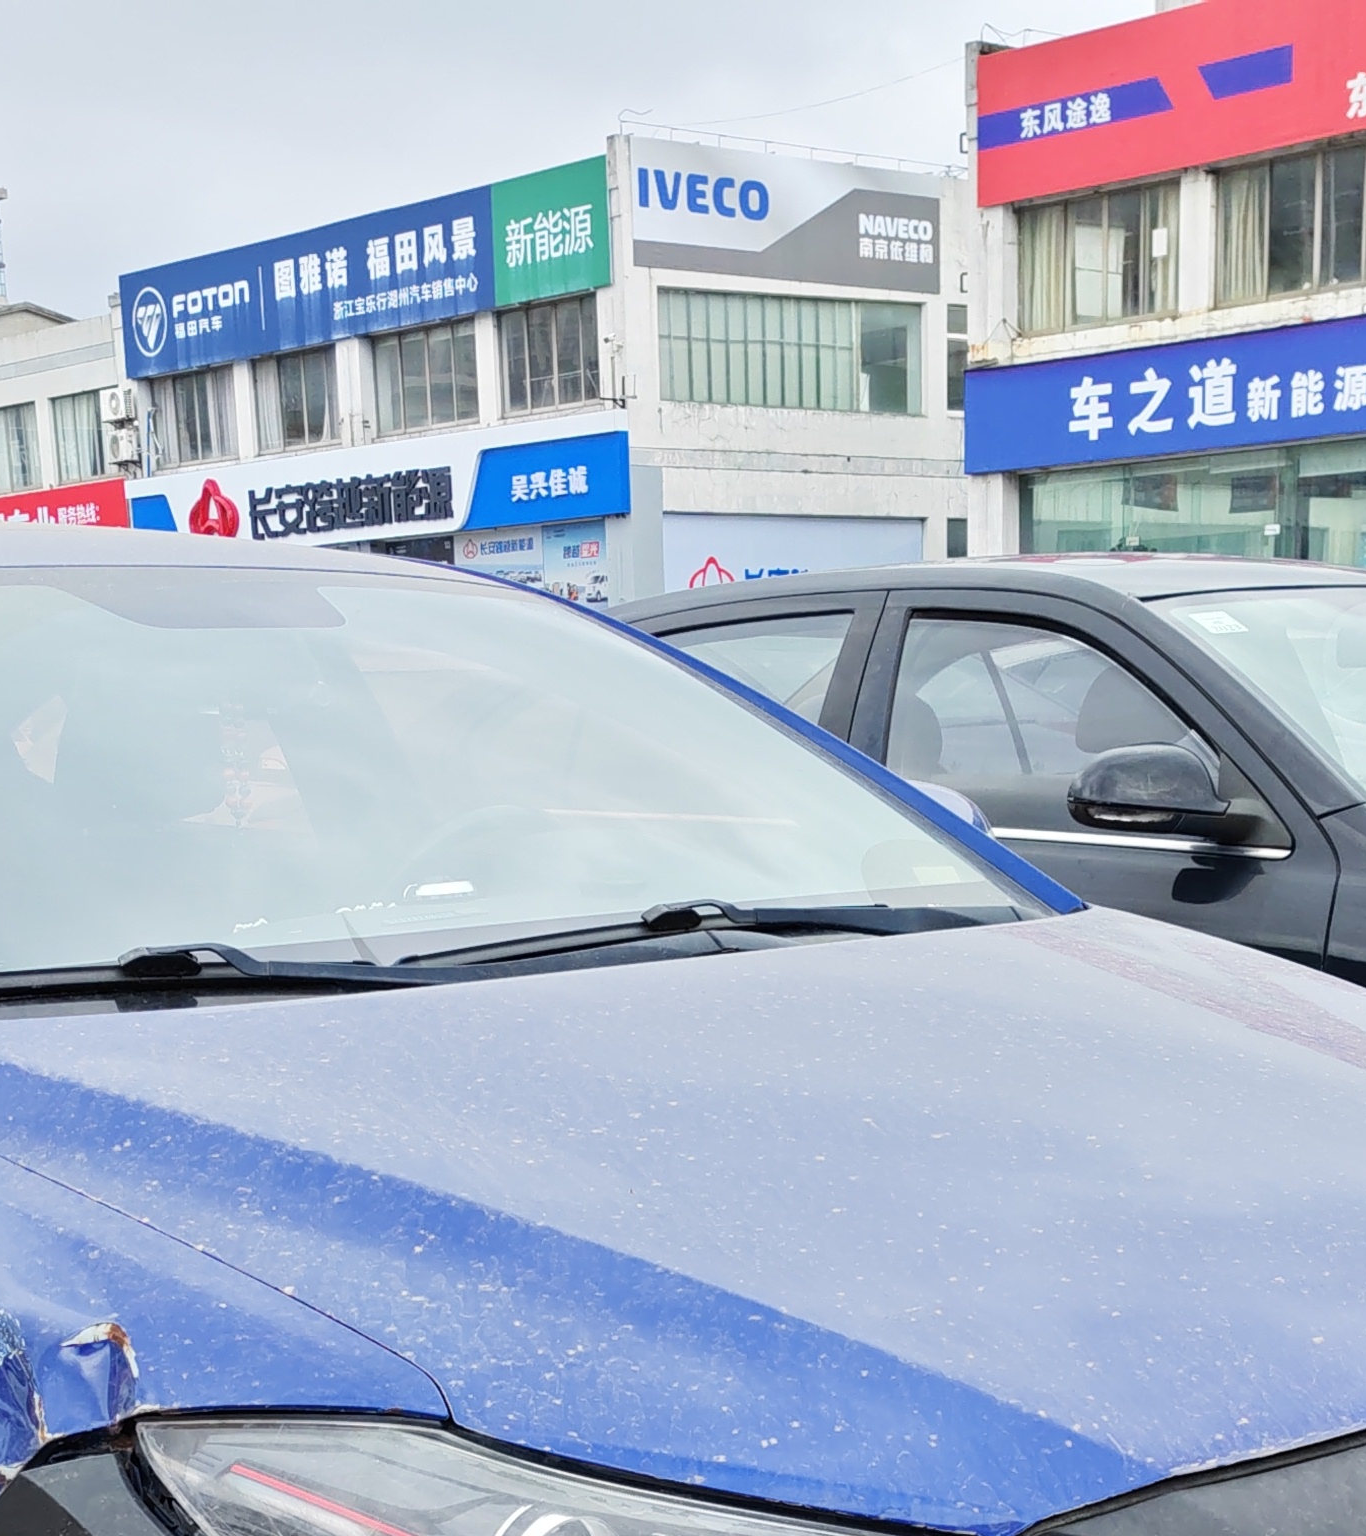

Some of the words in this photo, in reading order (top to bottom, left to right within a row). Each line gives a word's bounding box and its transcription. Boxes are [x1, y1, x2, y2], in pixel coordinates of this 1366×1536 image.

[1020, 92, 1111, 138] 东风途逸
[637, 167, 769, 221] IVECO
[505, 203, 594, 268] 新能源
[858, 213, 933, 241] NAVECO
[273, 246, 348, 301] 图雅诺
[366, 215, 477, 280] 福田风景
[859, 237, 934, 264] 南京依维柯
[172, 279, 250, 319] FOTON
[332, 273, 478, 320] 浙江宝乐行湖州汽车销售中心
[174, 316, 223, 339] 福田汽车
[1068, 357, 1237, 441] 车之道
[249, 466, 454, 540] 长安跨越新能源
[511, 465, 589, 502] 吴兴佳诚
